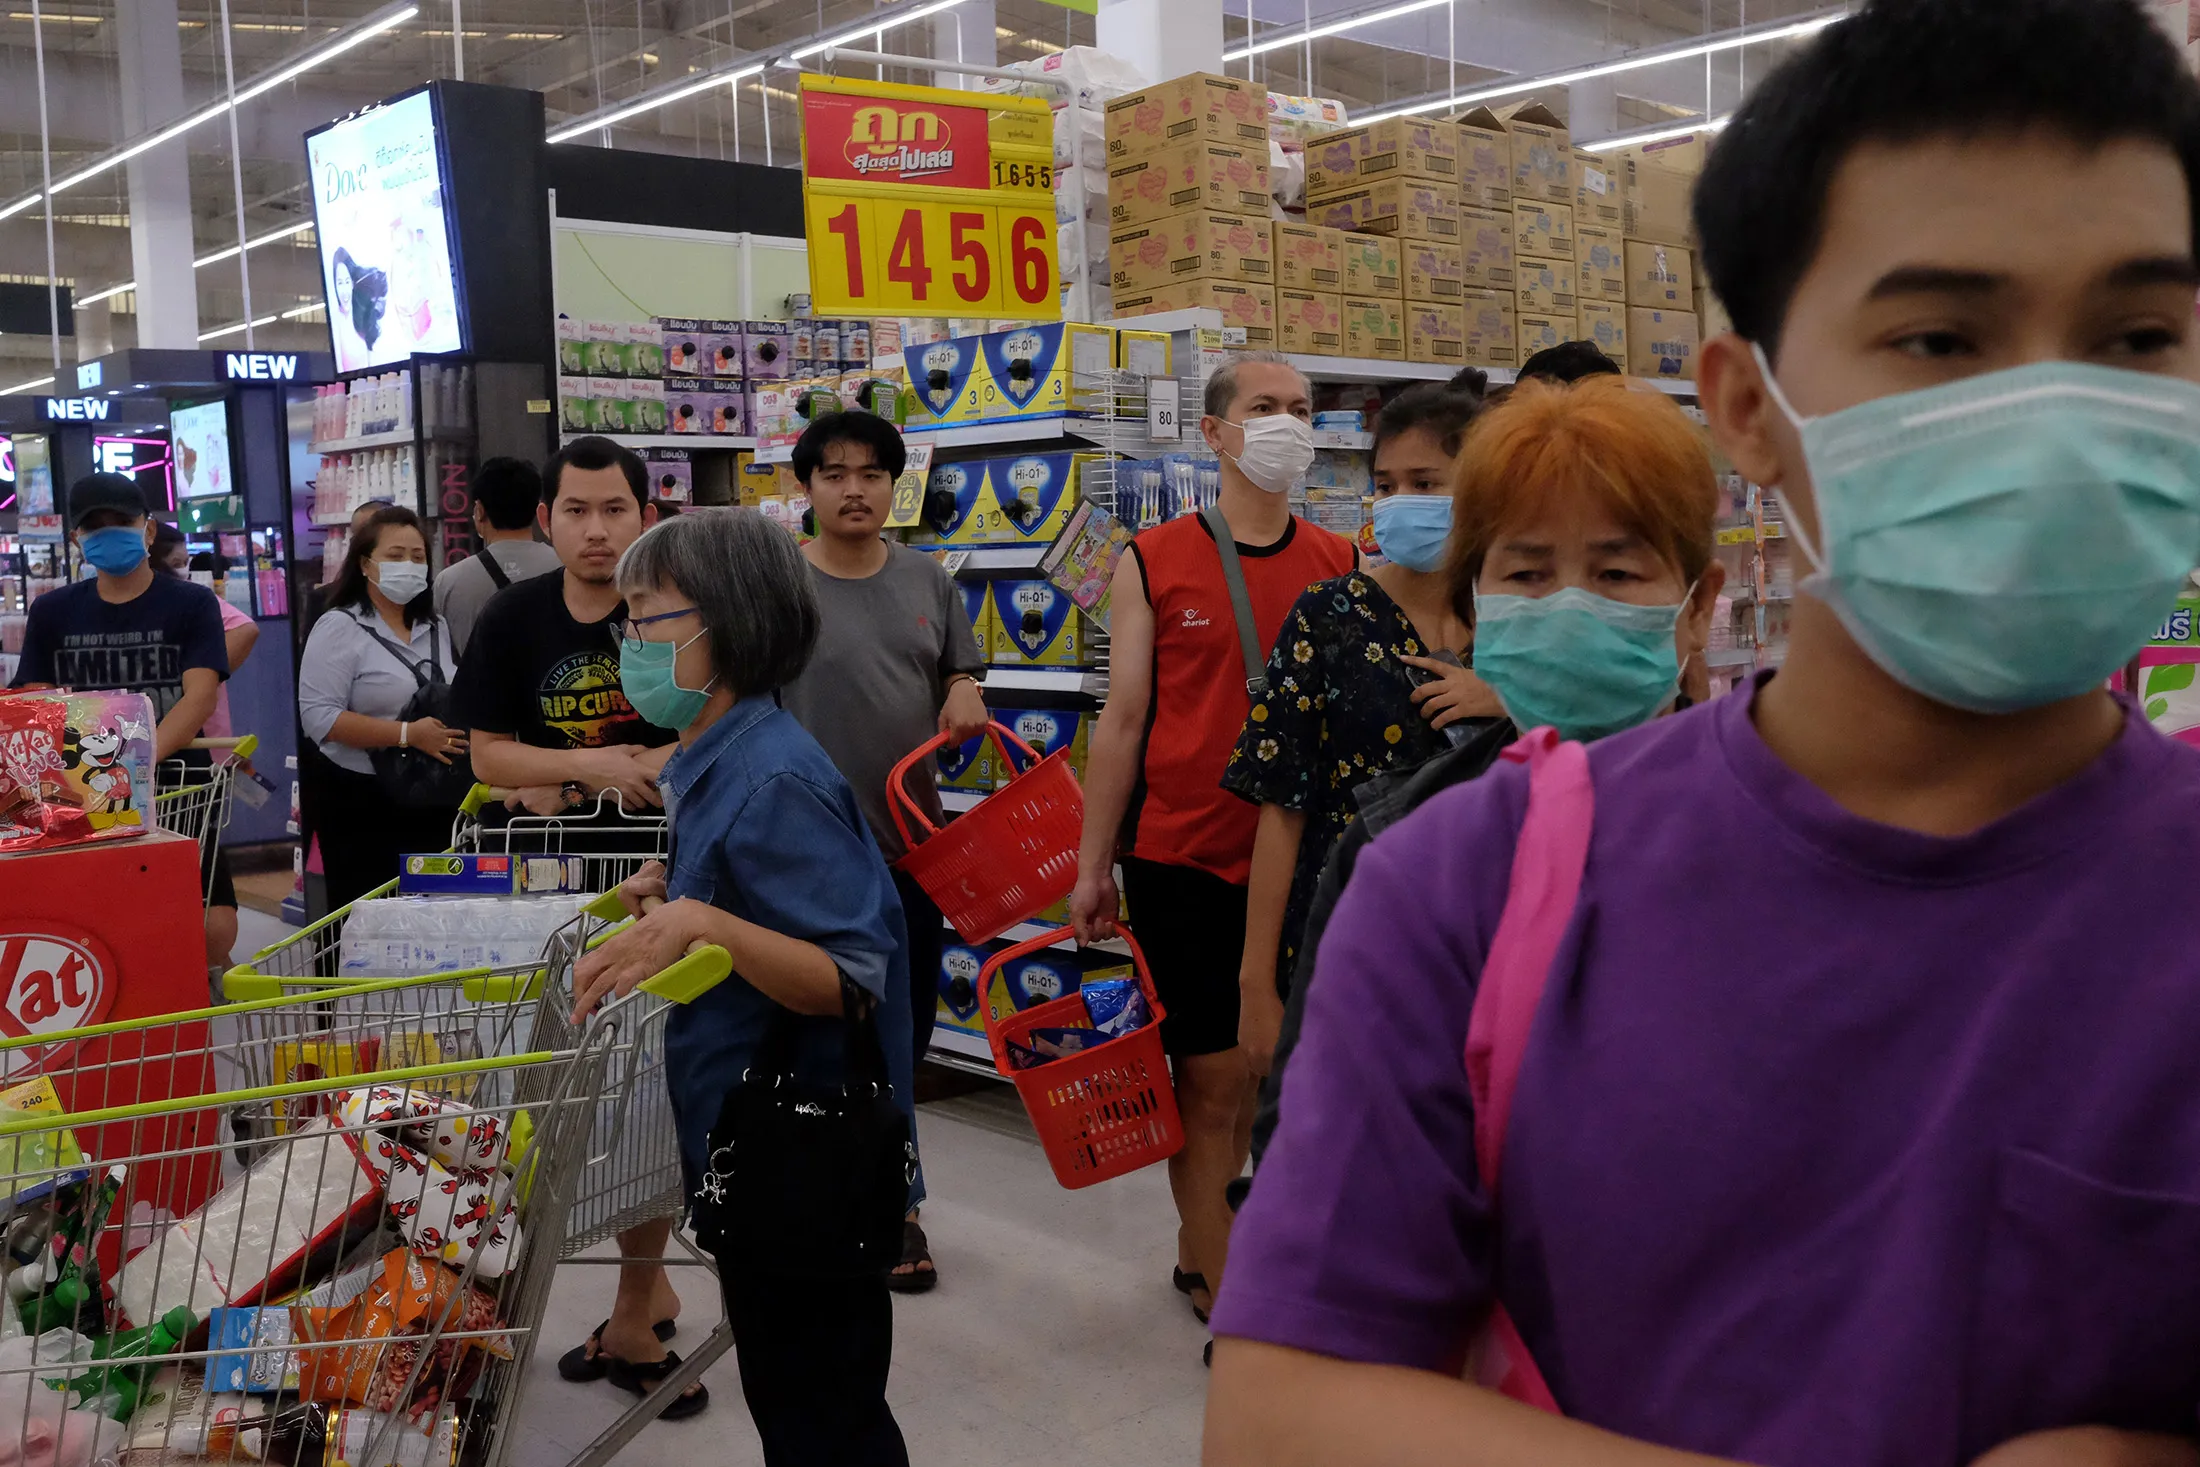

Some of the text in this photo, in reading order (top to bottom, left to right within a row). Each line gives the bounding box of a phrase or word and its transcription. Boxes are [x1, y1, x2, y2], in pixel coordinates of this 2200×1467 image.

[852, 106, 939, 155] ถูก
[1110, 139, 1122, 153] 80
[853, 145, 953, 174] สุดสุดไปเลย
[993, 161, 1051, 190] 1655
[1308, 172, 1320, 183] 80
[325, 162, 367, 204] Dove
[1112, 205, 1124, 218] 80
[828, 203, 1050, 305] 1456
[1210, 251, 1221, 260] 80
[1114, 271, 1126, 283] 80
[1009, 338, 1033, 353] Hi-Q1
[928, 352, 951, 365] Hi-Q1
[226, 353, 297, 380] NEW
[1054, 379, 1062, 395] 3
[969, 390, 977, 405] 3
[47, 398, 109, 420] NEW
[1159, 411, 1172, 425] 80
[1015, 465, 1040, 480] Hi-Q1
[935, 474, 957, 486] Hi-Q1
[976, 513, 984, 529] 3
[1020, 591, 1045, 603] Hi-Q1
[1182, 618, 1211, 627] chariot
[82, 633, 105, 646] NOT
[977, 634, 984, 648] 3
[1065, 635, 1074, 650] 3
[550, 661, 575, 685] LIVE
[571, 656, 590, 668] THE
[541, 694, 577, 719] RIP
[1022, 721, 1047, 733] Hi-Q1
[981, 761, 989, 775] 3
[949, 958, 972, 971] Hi-Q1
[1028, 974, 1052, 988] Hi-Q1
[990, 1006, 998, 1020] 3
[21, 1095, 43, 1110] 240
